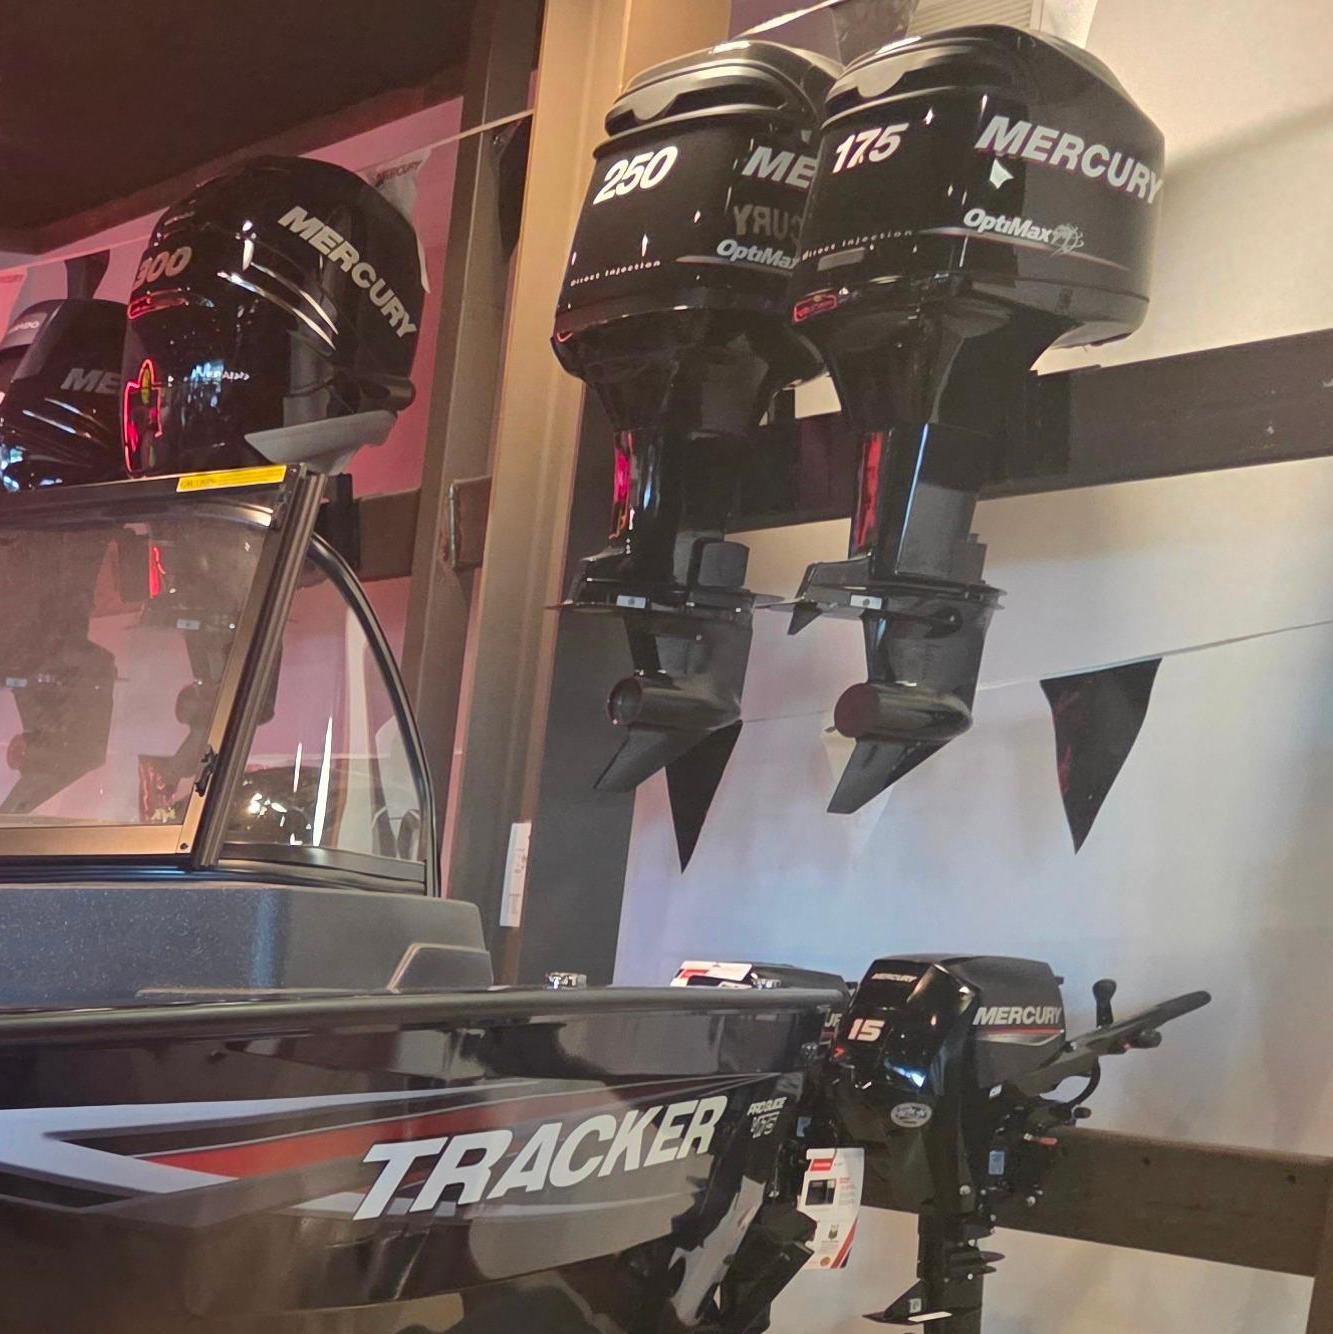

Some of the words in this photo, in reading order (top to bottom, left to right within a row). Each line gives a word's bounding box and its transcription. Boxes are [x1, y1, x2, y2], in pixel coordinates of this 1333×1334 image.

[833, 122, 910, 174] 175
[975, 115, 1164, 204] MERCURY
[593, 145, 678, 205] 250
[963, 208, 1051, 244] OptiMax
[133, 246, 192, 289] 300
[277, 206, 417, 339] MERCURY
[871, 973, 918, 983] MERCURY
[847, 1018, 885, 1042] 15
[973, 1005, 1061, 1026] MERCURY
[353, 1095, 729, 1221] TRACKER
